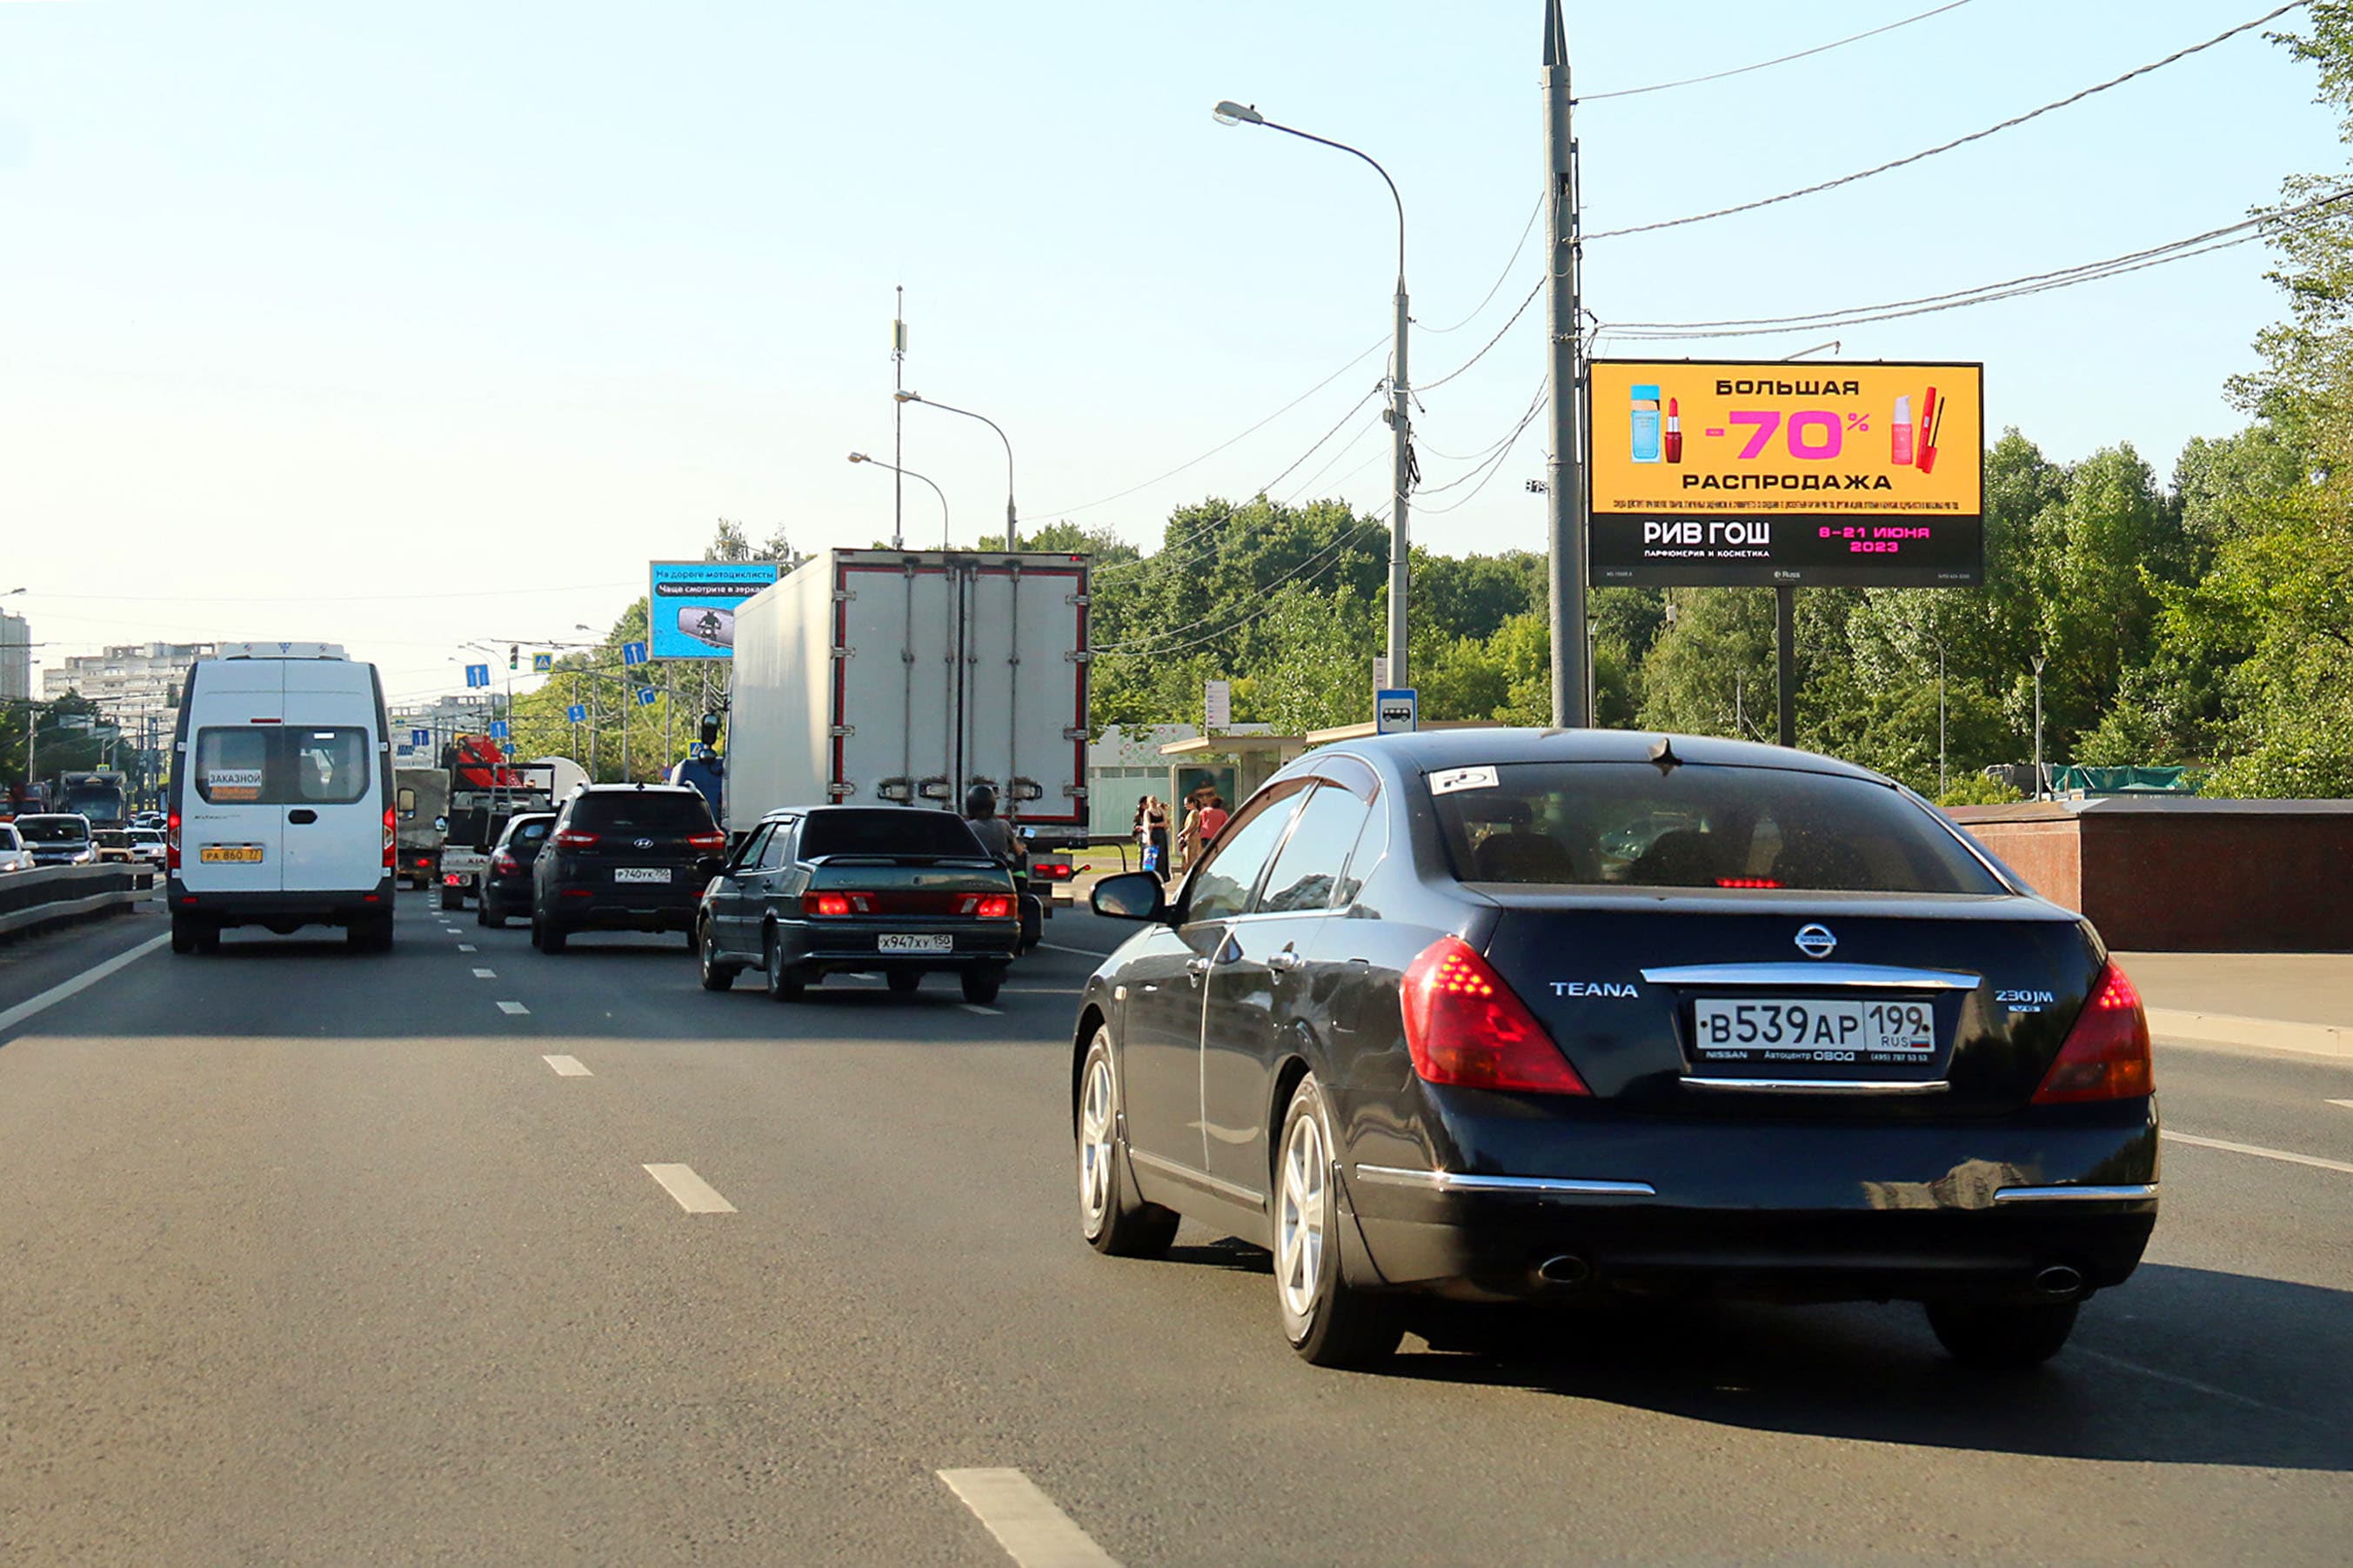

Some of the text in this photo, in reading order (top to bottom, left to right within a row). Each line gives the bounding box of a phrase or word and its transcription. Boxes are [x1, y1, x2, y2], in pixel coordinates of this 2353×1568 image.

[1715, 379, 1859, 396] БОЛЬШАЯ
[1682, 474, 1893, 490] РАСПРОДАЖА
[1643, 522, 1770, 544] РИВ ГОШ
[1873, 527, 1931, 539] ИЮНЯ
[1849, 541, 1899, 553] 2023
[671, 570, 704, 580] дороге
[658, 584, 684, 594] Чаще
[685, 586, 725, 595] смотрите
[210, 772, 261, 784] ЗАКАЗНОЙ
[1549, 982, 1639, 998] TEANA
[1995, 990, 2054, 1004] 230JM
[1710, 1005, 1858, 1044] В539АР
[1868, 1004, 1924, 1035] 199
[1881, 1036, 1909, 1048] RUS
[1705, 1051, 1748, 1059] NISSAN
[1763, 1051, 1812, 1061] Автоцентр
